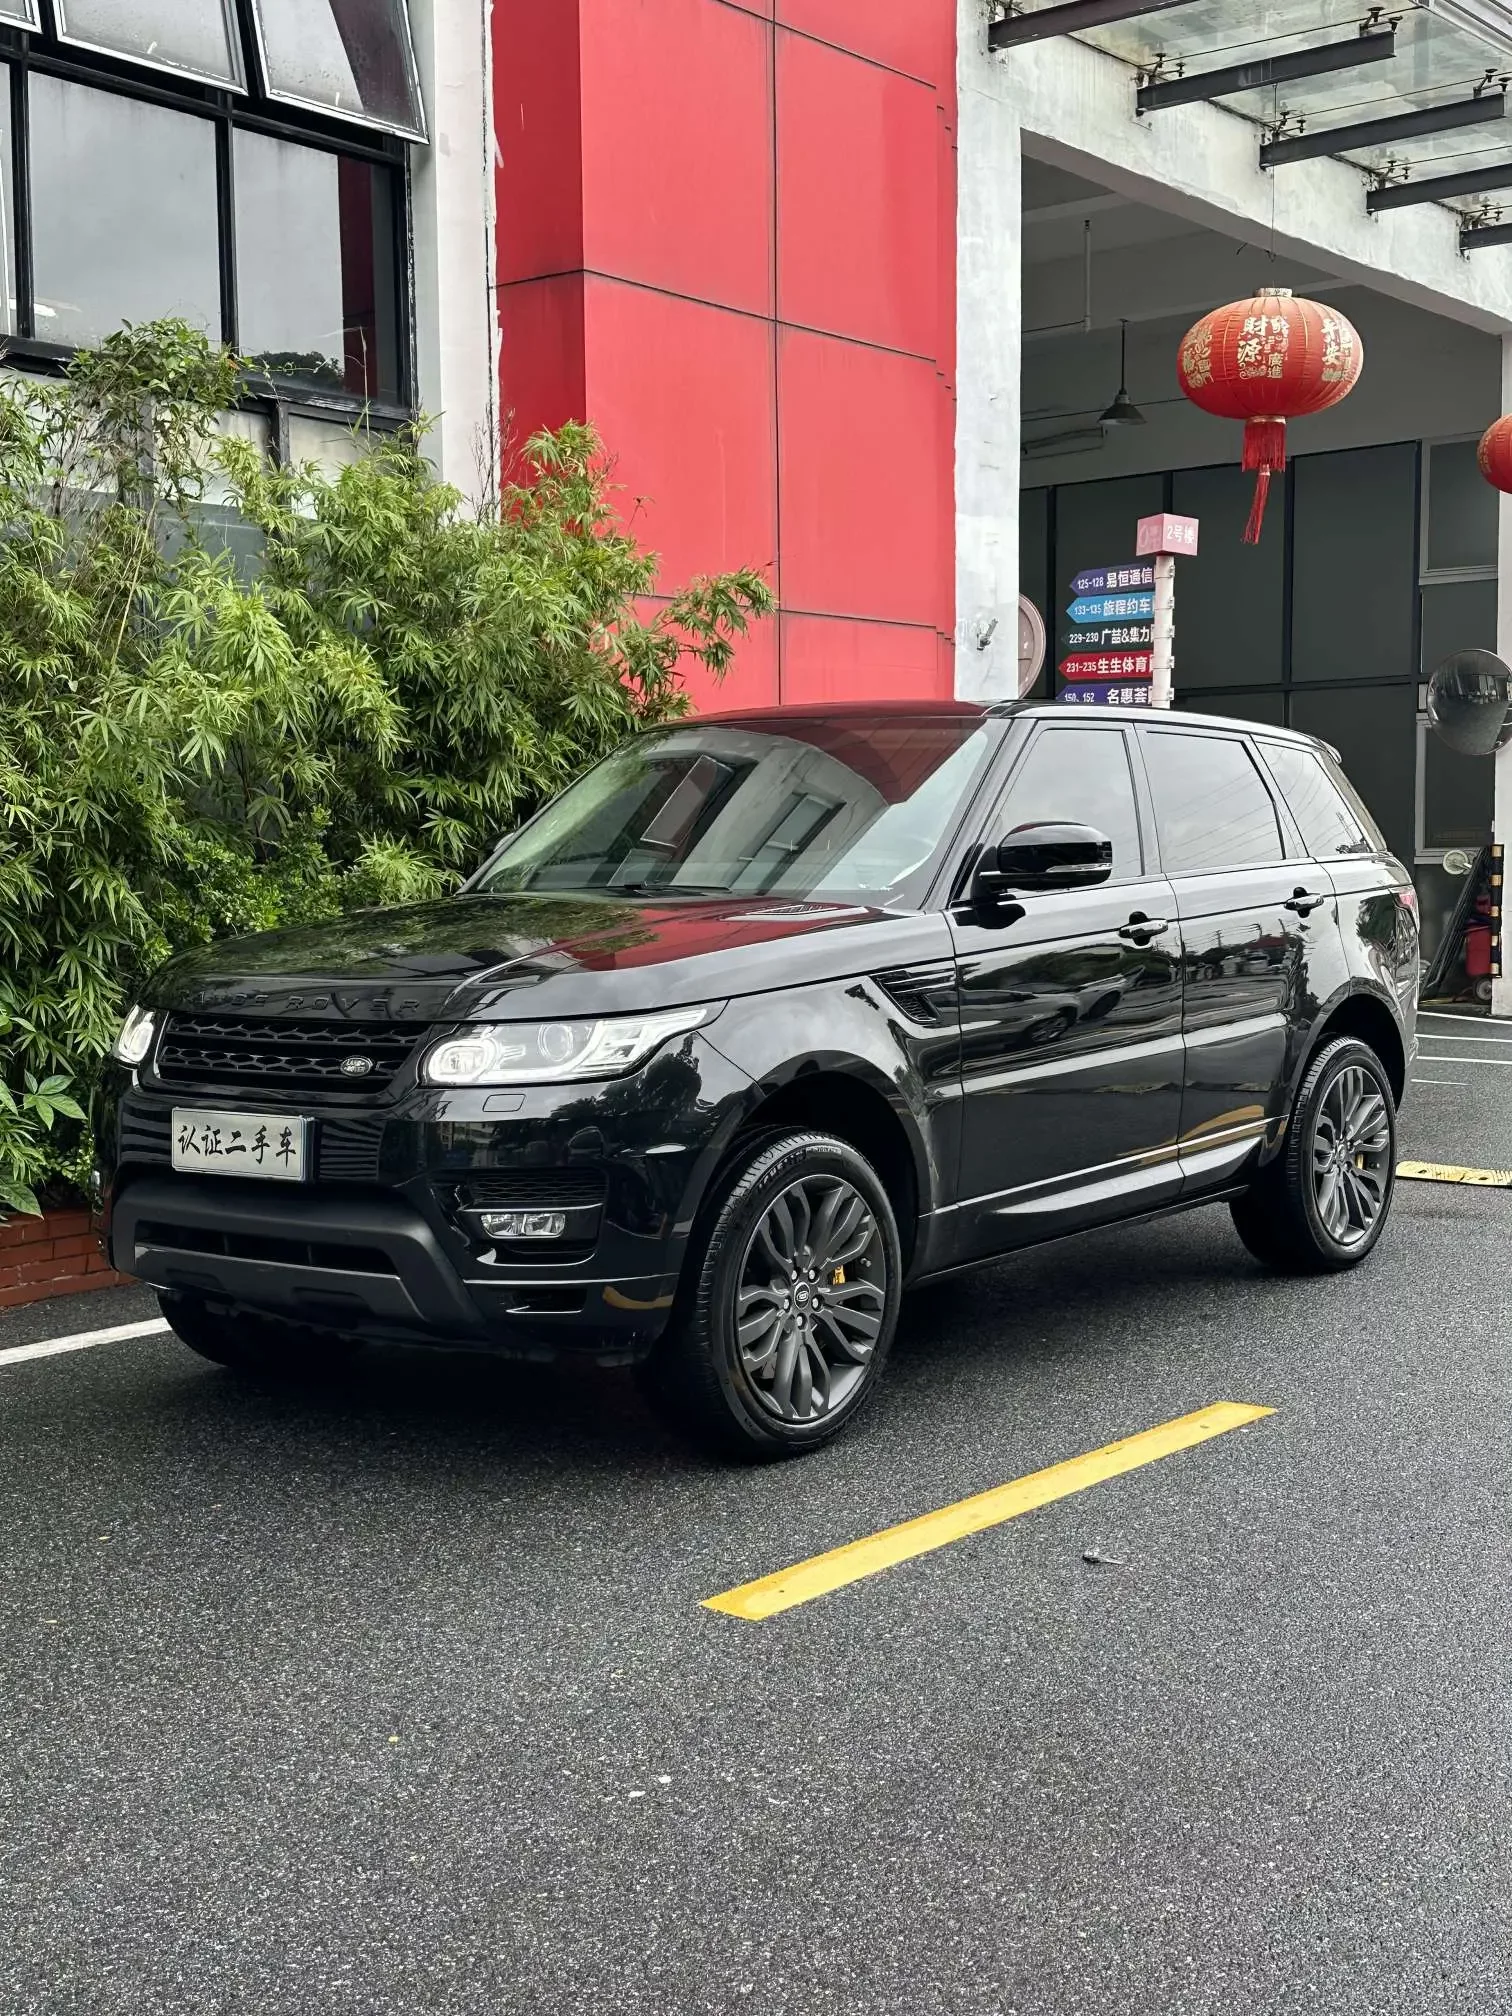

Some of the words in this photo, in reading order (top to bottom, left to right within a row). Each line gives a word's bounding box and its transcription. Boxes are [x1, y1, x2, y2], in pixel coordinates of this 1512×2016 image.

[1167, 524, 1195, 545] 2号楼
[1077, 577, 1104, 590] 125-128
[1106, 567, 1153, 588] 易恒通信
[1103, 596, 1151, 616] 旅程约车
[1069, 632, 1099, 644] 229-230
[1066, 661, 1096, 673] 231-235
[1097, 655, 1147, 674] 生生体育
[1107, 687, 1147, 704] 名惠荟
[285, 994, 420, 1015] ROVER
[177, 1124, 297, 1168] 认证二手车
